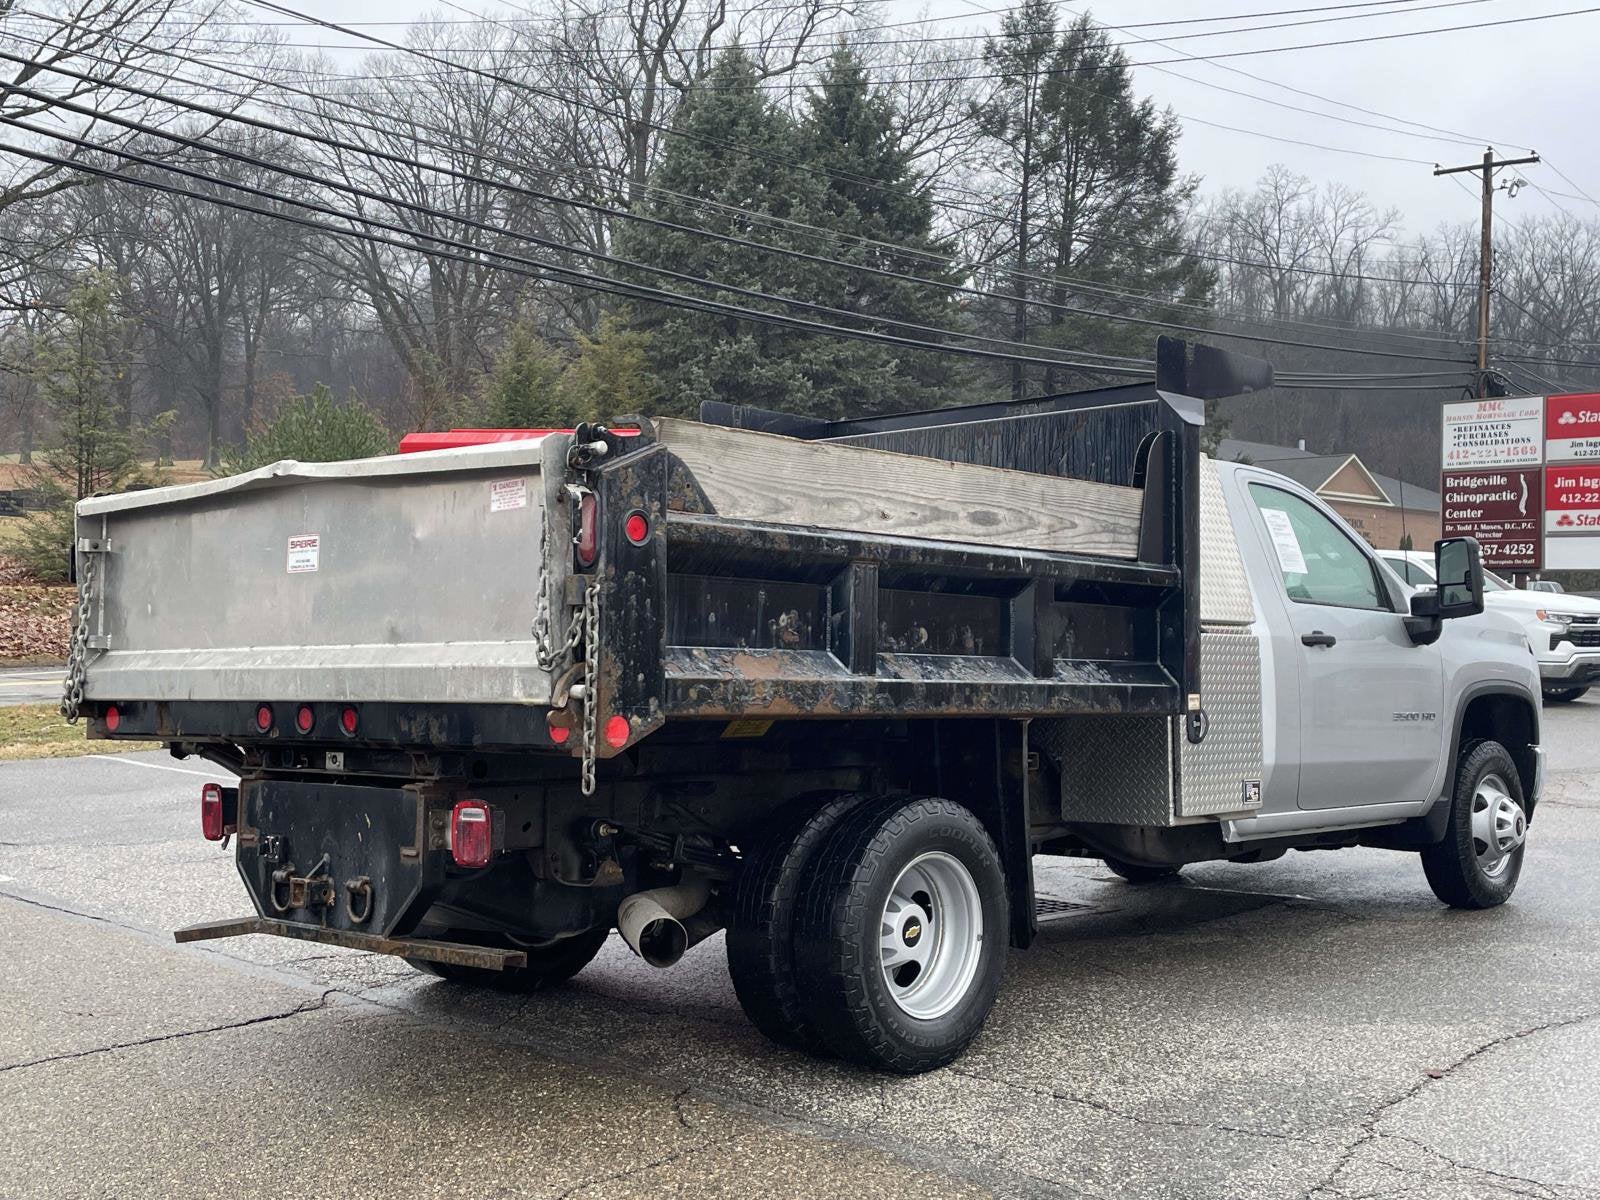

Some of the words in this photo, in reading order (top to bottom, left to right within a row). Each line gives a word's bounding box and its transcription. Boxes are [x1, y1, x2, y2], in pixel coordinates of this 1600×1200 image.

[1446, 475, 1508, 489] Bridgeville
[1554, 477, 1576, 488] Jim
[1580, 476, 1600, 489] Iag
[1445, 490, 1518, 503] Chiropractic
[1445, 508, 1483, 519] Center
[290, 539, 318, 549] SABRE
